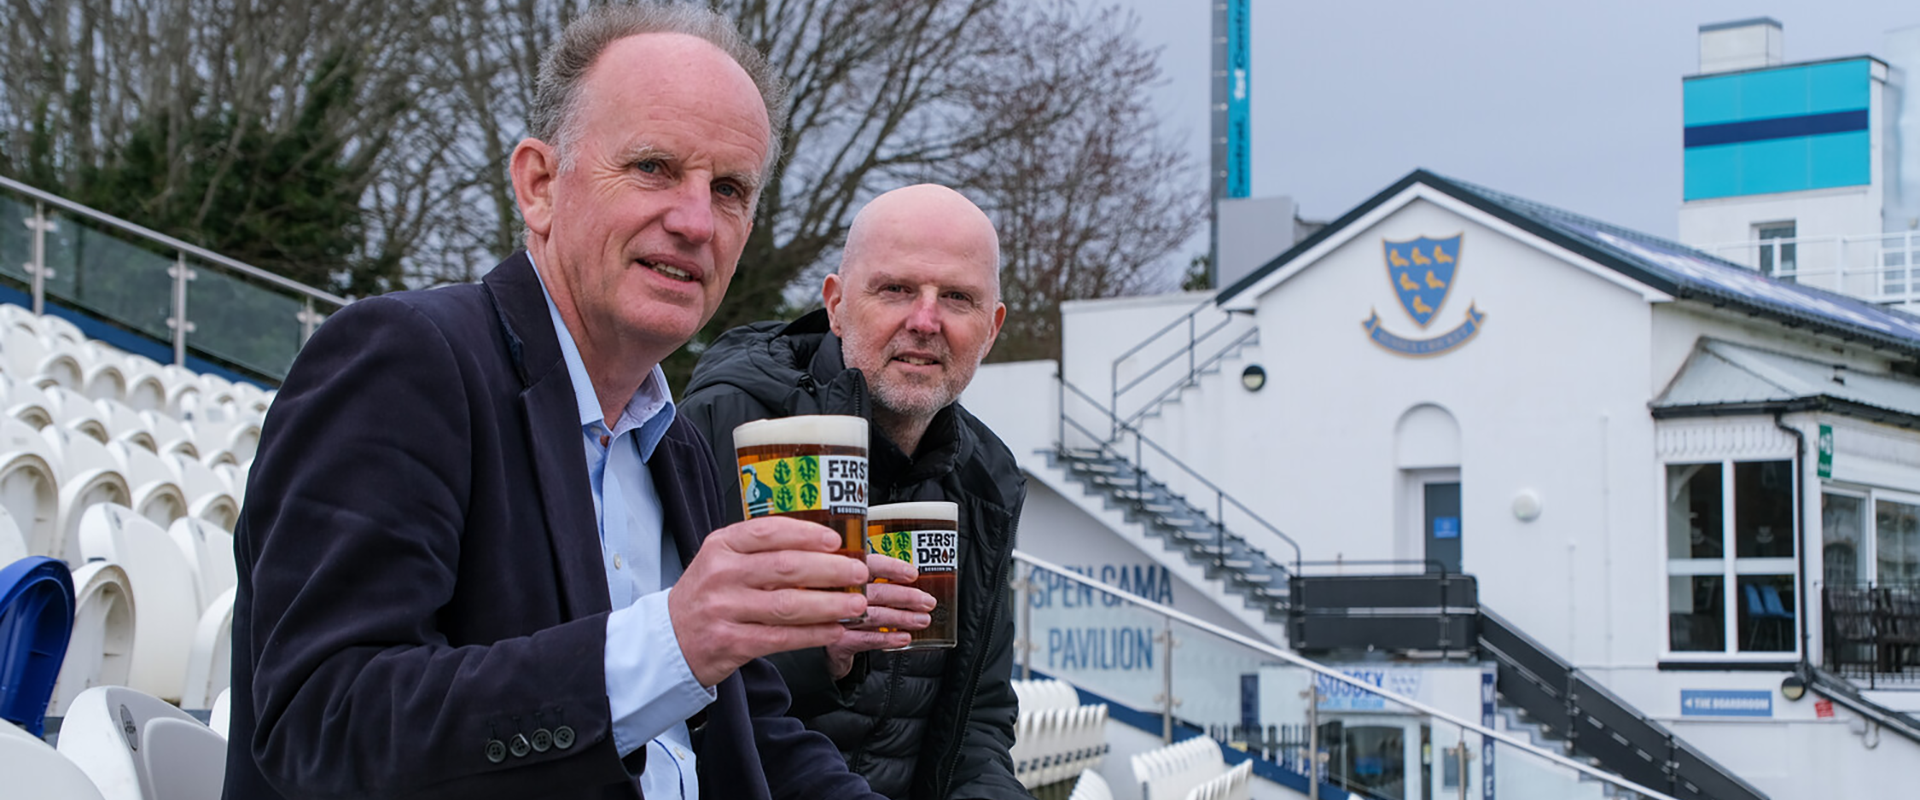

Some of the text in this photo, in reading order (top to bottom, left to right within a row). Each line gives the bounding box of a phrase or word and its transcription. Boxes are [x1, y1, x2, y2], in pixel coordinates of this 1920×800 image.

[828, 459, 868, 480] FIRS
[917, 533, 956, 547] FIRST
[917, 547, 956, 564] DROP
[1030, 564, 1093, 608] SPEN
[1048, 627, 1154, 671] PAVILION
